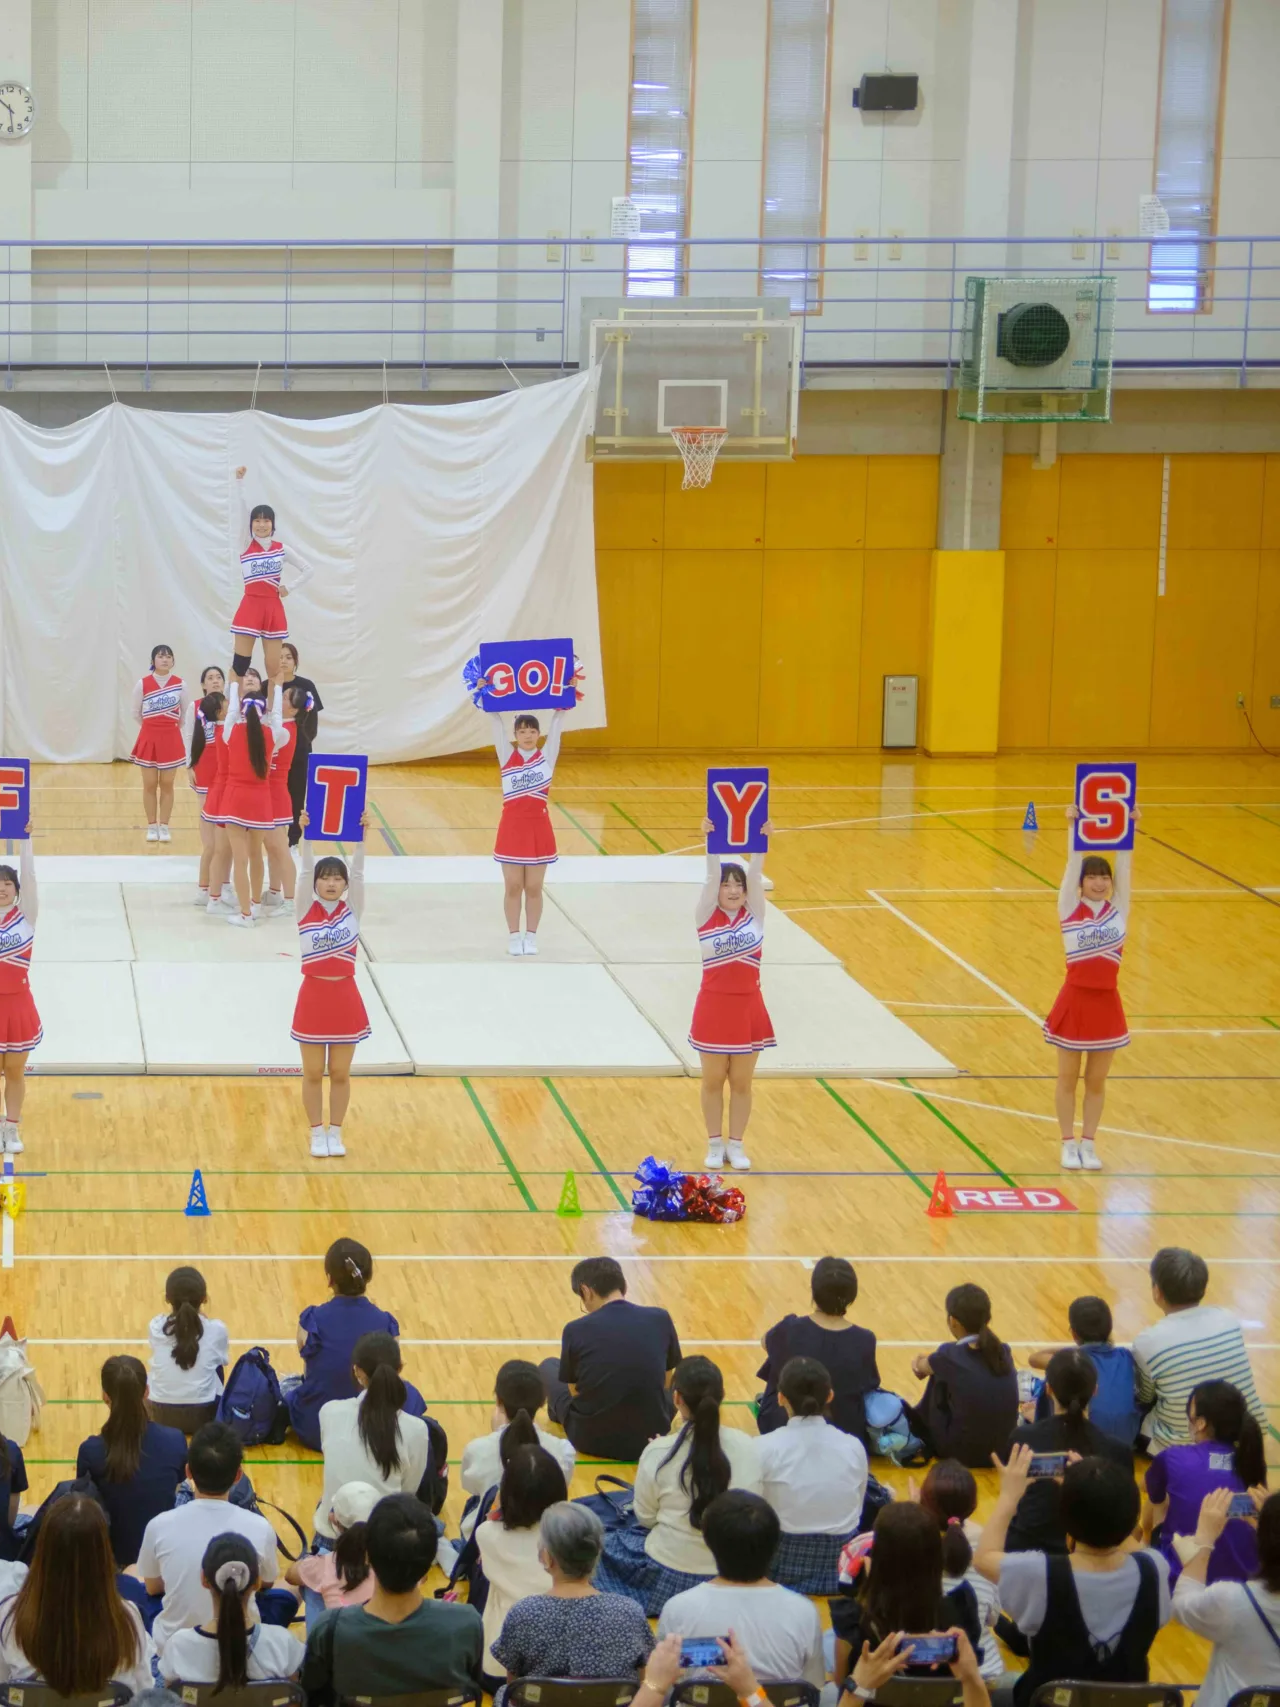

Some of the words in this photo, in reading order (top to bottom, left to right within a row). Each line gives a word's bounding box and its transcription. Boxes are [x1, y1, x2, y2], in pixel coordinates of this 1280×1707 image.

[483, 656, 566, 698] GO!
[314, 765, 360, 835] T
[712, 781, 767, 846] Y
[1078, 772, 1131, 844] S
[954, 1190, 1061, 1207] RED
